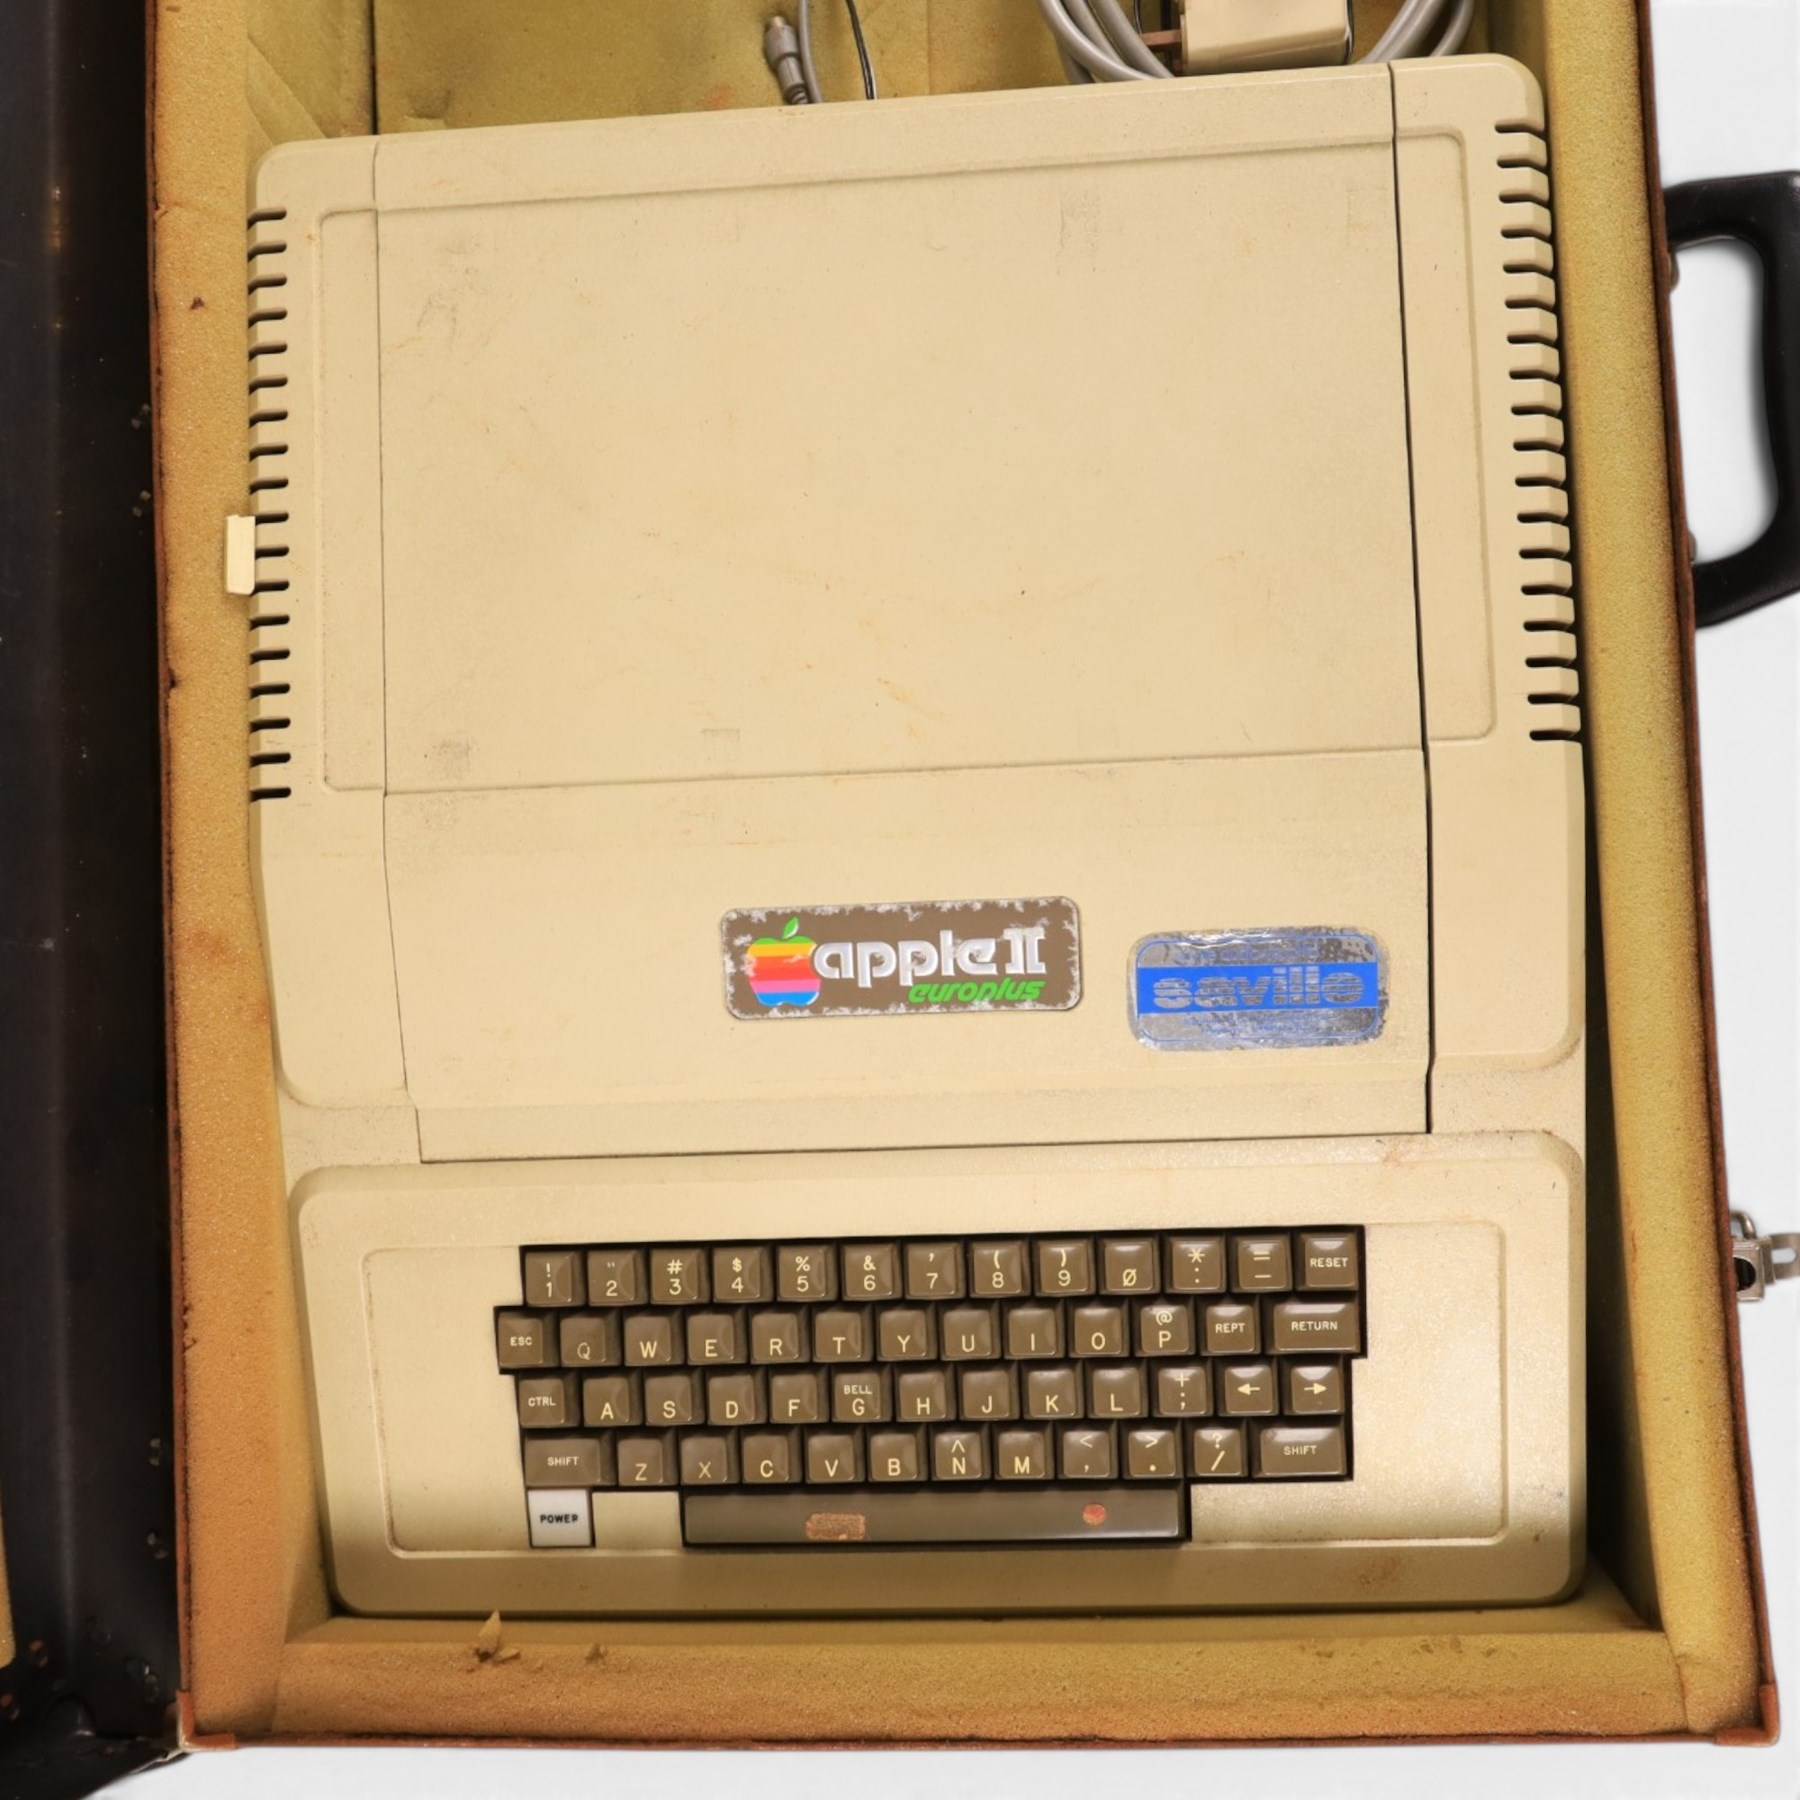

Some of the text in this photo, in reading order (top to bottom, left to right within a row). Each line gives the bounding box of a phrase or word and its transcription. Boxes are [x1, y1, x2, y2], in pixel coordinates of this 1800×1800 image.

[814, 929, 998, 988] apple
[908, 978, 1046, 1004] europlus
[1153, 964, 1363, 1009] saville
[667, 1259, 682, 1274] #
[732, 1257, 742, 1272] $
[795, 1256, 810, 1272] %
[864, 1255, 876, 1271] &
[993, 1250, 1000, 1269] (
[1060, 1249, 1067, 1267] )
[1310, 1257, 1348, 1268] RESET
[669, 1279, 682, 1295] 3
[731, 1277, 744, 1293] 4
[797, 1276, 809, 1292] 5
[863, 1274, 875, 1291] 6
[926, 1273, 938, 1289] 7
[992, 1272, 1004, 1288] 8
[1058, 1270, 1071, 1287] 9
[546, 1282, 552, 1297] 1
[606, 1280, 618, 1296] 2
[1156, 1311, 1173, 1325] @
[1291, 1321, 1338, 1331] RETURN
[1215, 1323, 1245, 1333] REPT
[510, 1336, 532, 1346] ESC
[705, 1339, 718, 1357] E
[769, 1338, 783, 1356] R
[833, 1337, 846, 1354] T
[897, 1335, 911, 1352] Y
[961, 1334, 975, 1352] U
[1091, 1332, 1106, 1350] O
[1159, 1331, 1171, 1348] P
[577, 1342, 590, 1360] Q
[640, 1341, 657, 1358] W
[1174, 1372, 1190, 1387] +
[843, 1385, 872, 1394] BELL
[528, 1397, 556, 1406] CTRL
[663, 1401, 676, 1418] S
[726, 1401, 739, 1418] D
[788, 1399, 800, 1417] F
[852, 1398, 865, 1415] G
[917, 1398, 931, 1415] H
[981, 1396, 993, 1414] J
[1045, 1395, 1059, 1413] K
[1111, 1394, 1124, 1411] L
[600, 1402, 614, 1419] A
[1079, 1435, 1093, 1448] <
[1145, 1435, 1158, 1448] >
[1212, 1433, 1222, 1449] ?
[1283, 1445, 1317, 1455] SHIFT
[547, 1457, 579, 1466] SHIFT
[760, 1460, 774, 1477] C
[825, 1460, 839, 1477] V
[888, 1458, 900, 1475] B
[953, 1457, 966, 1475] N
[1014, 1456, 1030, 1474] M
[1211, 1451, 1225, 1471] /
[635, 1463, 647, 1481] Z
[698, 1462, 712, 1479] X
[540, 1515, 578, 1524] POWER
